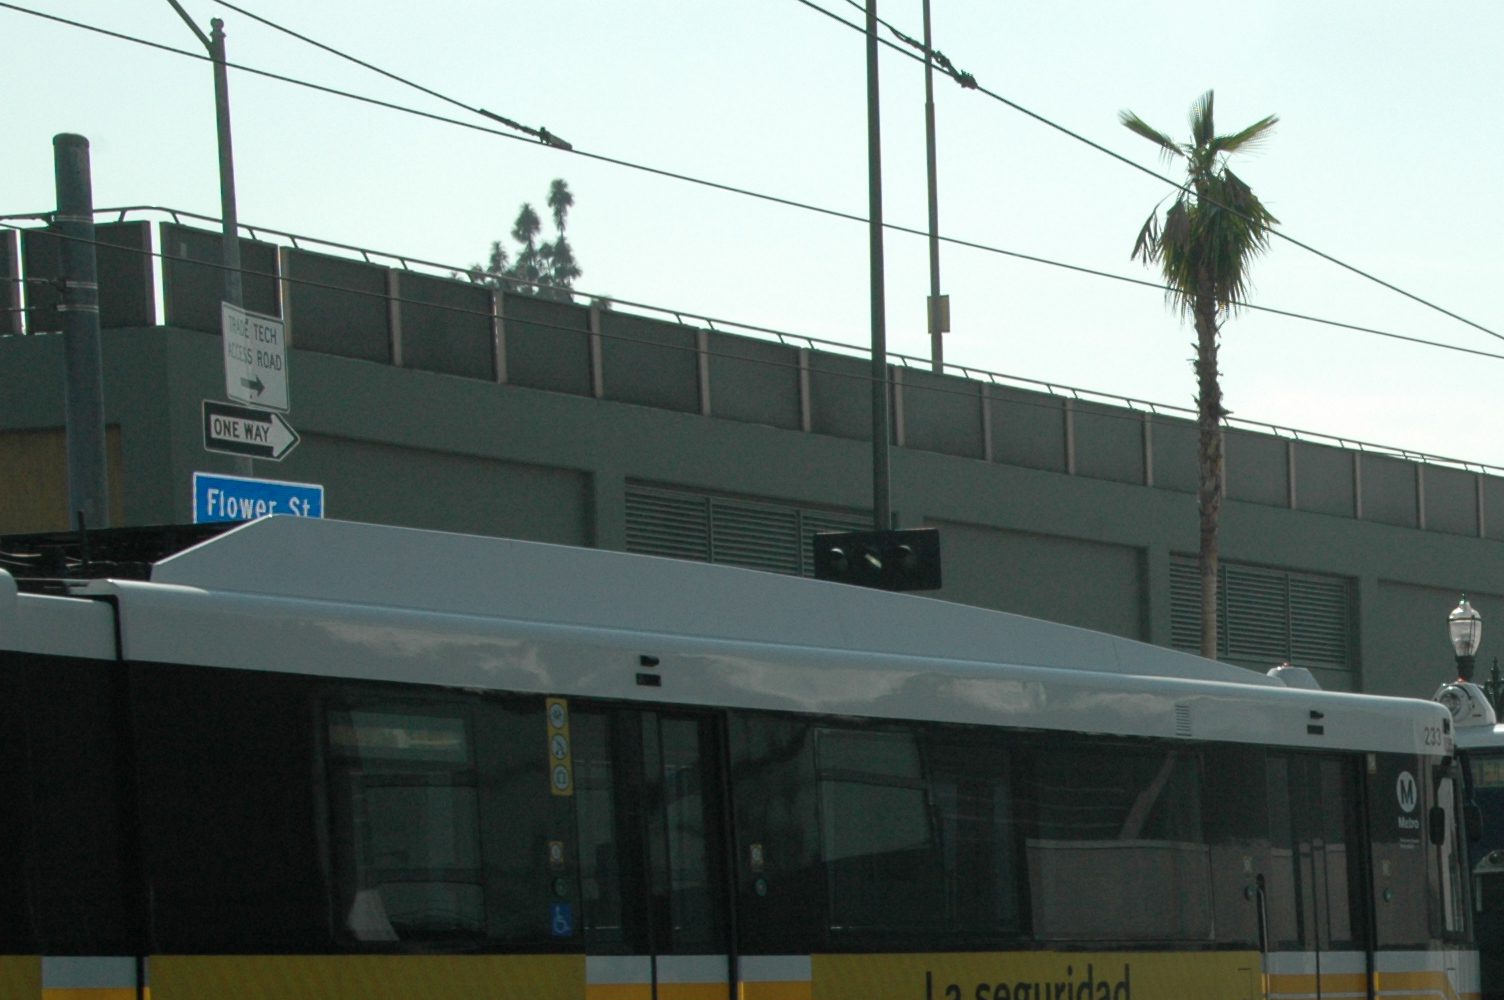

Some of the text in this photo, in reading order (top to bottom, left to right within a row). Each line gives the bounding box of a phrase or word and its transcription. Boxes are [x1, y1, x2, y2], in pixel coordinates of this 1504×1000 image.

[253, 323, 277, 344] TECH
[256, 349, 282, 371] ROAD
[213, 418, 271, 443] ONE WAY
[206, 487, 311, 519] Flower St
[1424, 727, 1442, 747] 233
